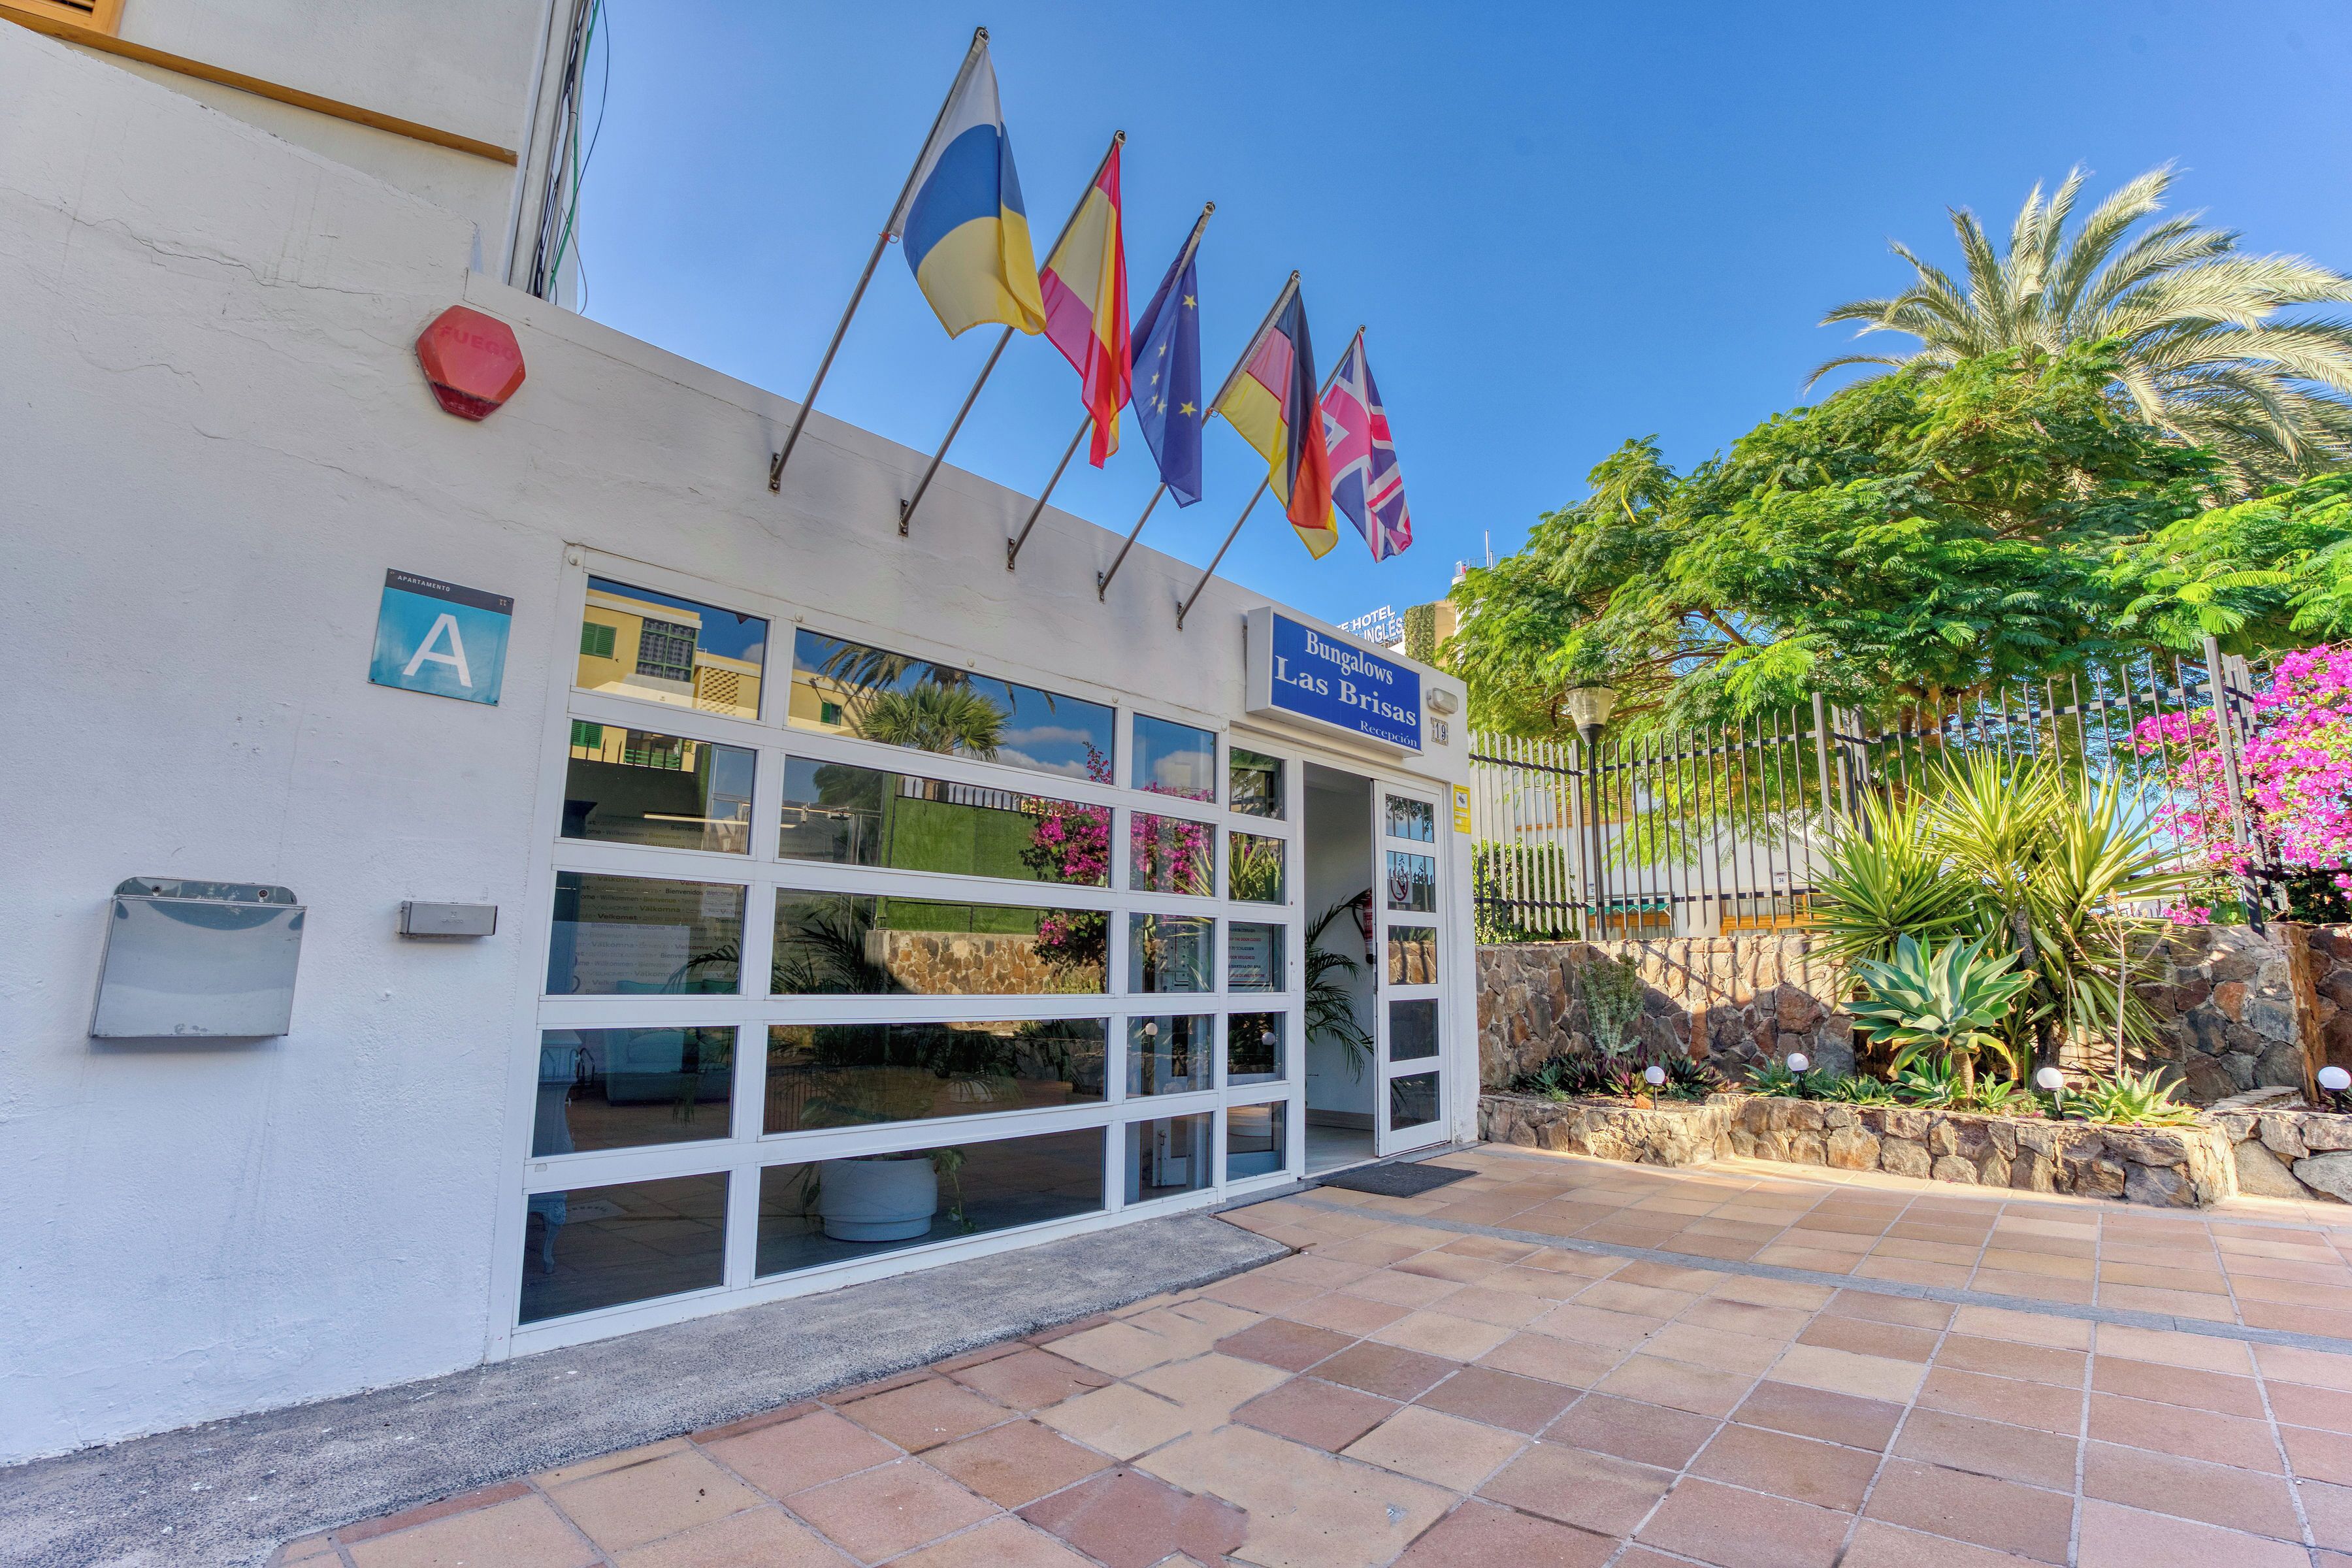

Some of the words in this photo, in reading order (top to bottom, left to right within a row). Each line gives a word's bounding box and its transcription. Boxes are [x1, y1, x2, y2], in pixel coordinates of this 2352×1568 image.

[438, 325, 516, 361] FUEGO
[397, 575, 451, 592] APARTAMENTO
[1352, 604, 1396, 631] HOTEL
[1364, 615, 1403, 644] INGLÉS
[402, 613, 472, 688] A
[1305, 629, 1393, 685] Bungalows
[1275, 655, 1329, 696] Las
[1338, 679, 1416, 727] Brisas
[1360, 720, 1417, 747] Recepción
[1435, 723, 1446, 740] 19
